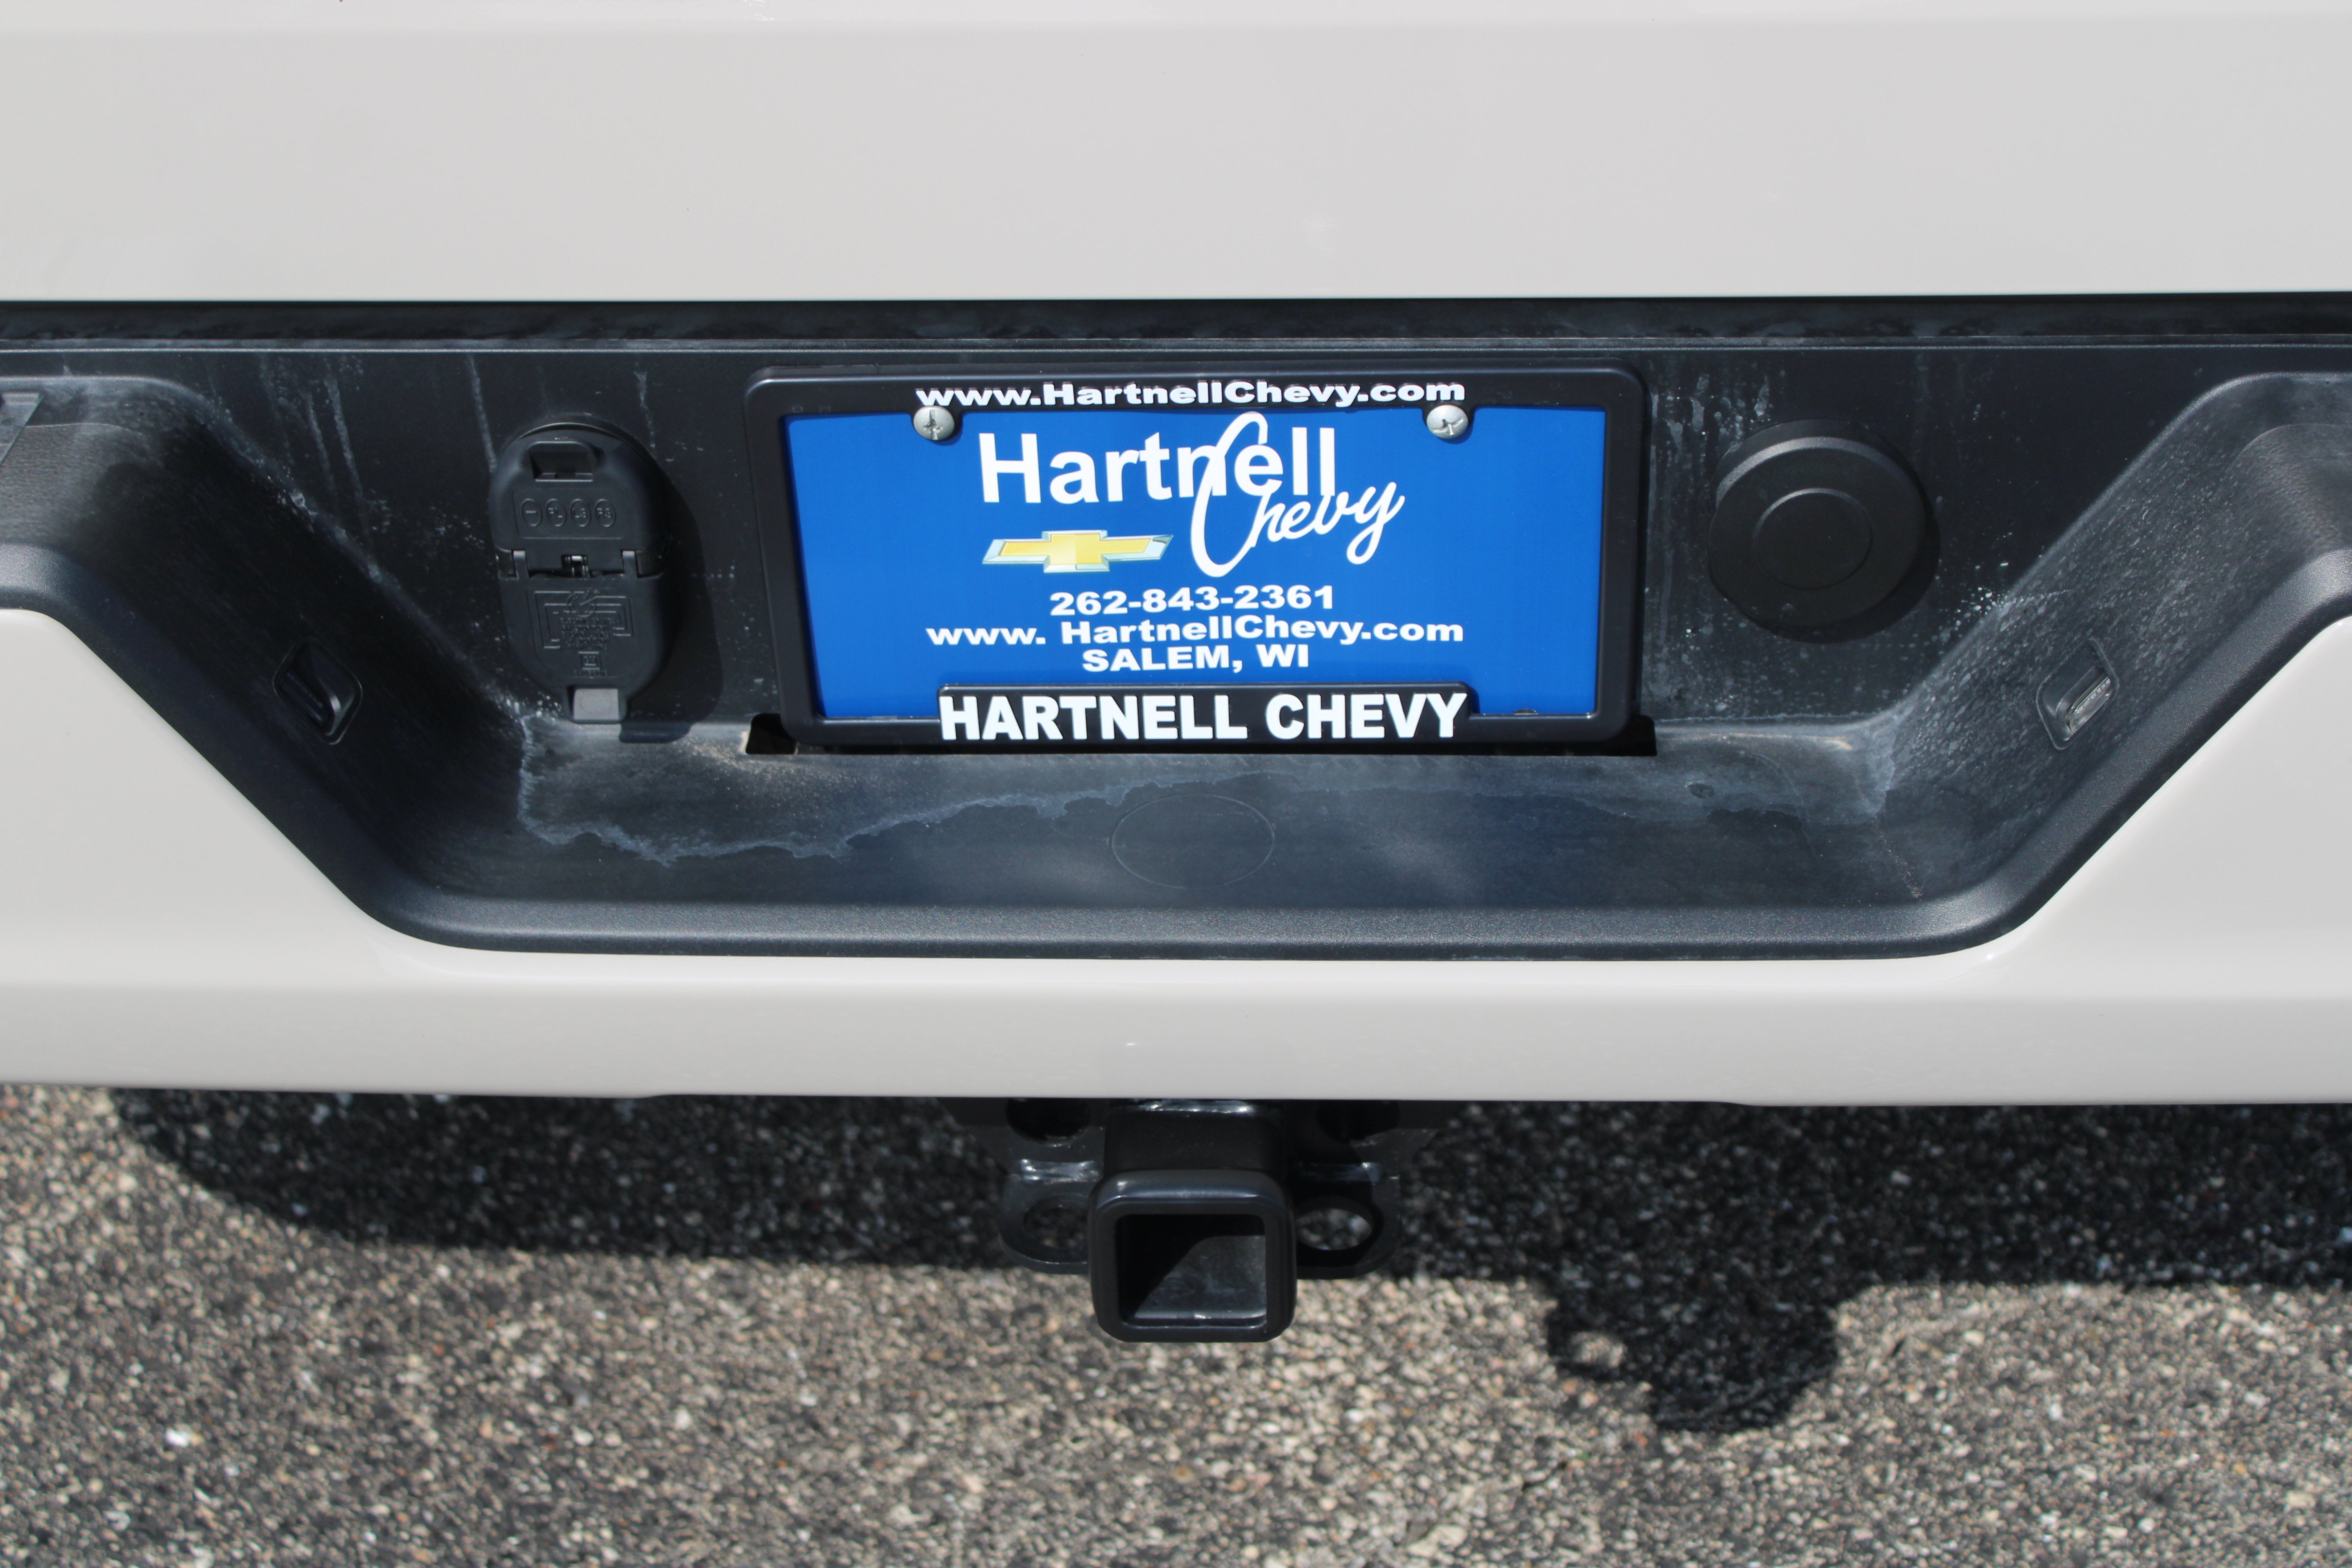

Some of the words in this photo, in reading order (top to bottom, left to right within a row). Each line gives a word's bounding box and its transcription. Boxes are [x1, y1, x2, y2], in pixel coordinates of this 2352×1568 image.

[915, 381, 1465, 408] www.HartnellChevy.com
[979, 426, 1336, 504] Hartnell
[1190, 411, 1405, 577] Chevy
[1050, 584, 1333, 615] 262-843-2361
[926, 628, 1046, 645] www.
[1061, 615, 1464, 645] HartnellChevy.com
[1083, 645, 1243, 673] SALEM,
[1256, 644, 1309, 667] WI
[939, 695, 1248, 740] HARTNELL
[1265, 693, 1467, 739] CHEVY
